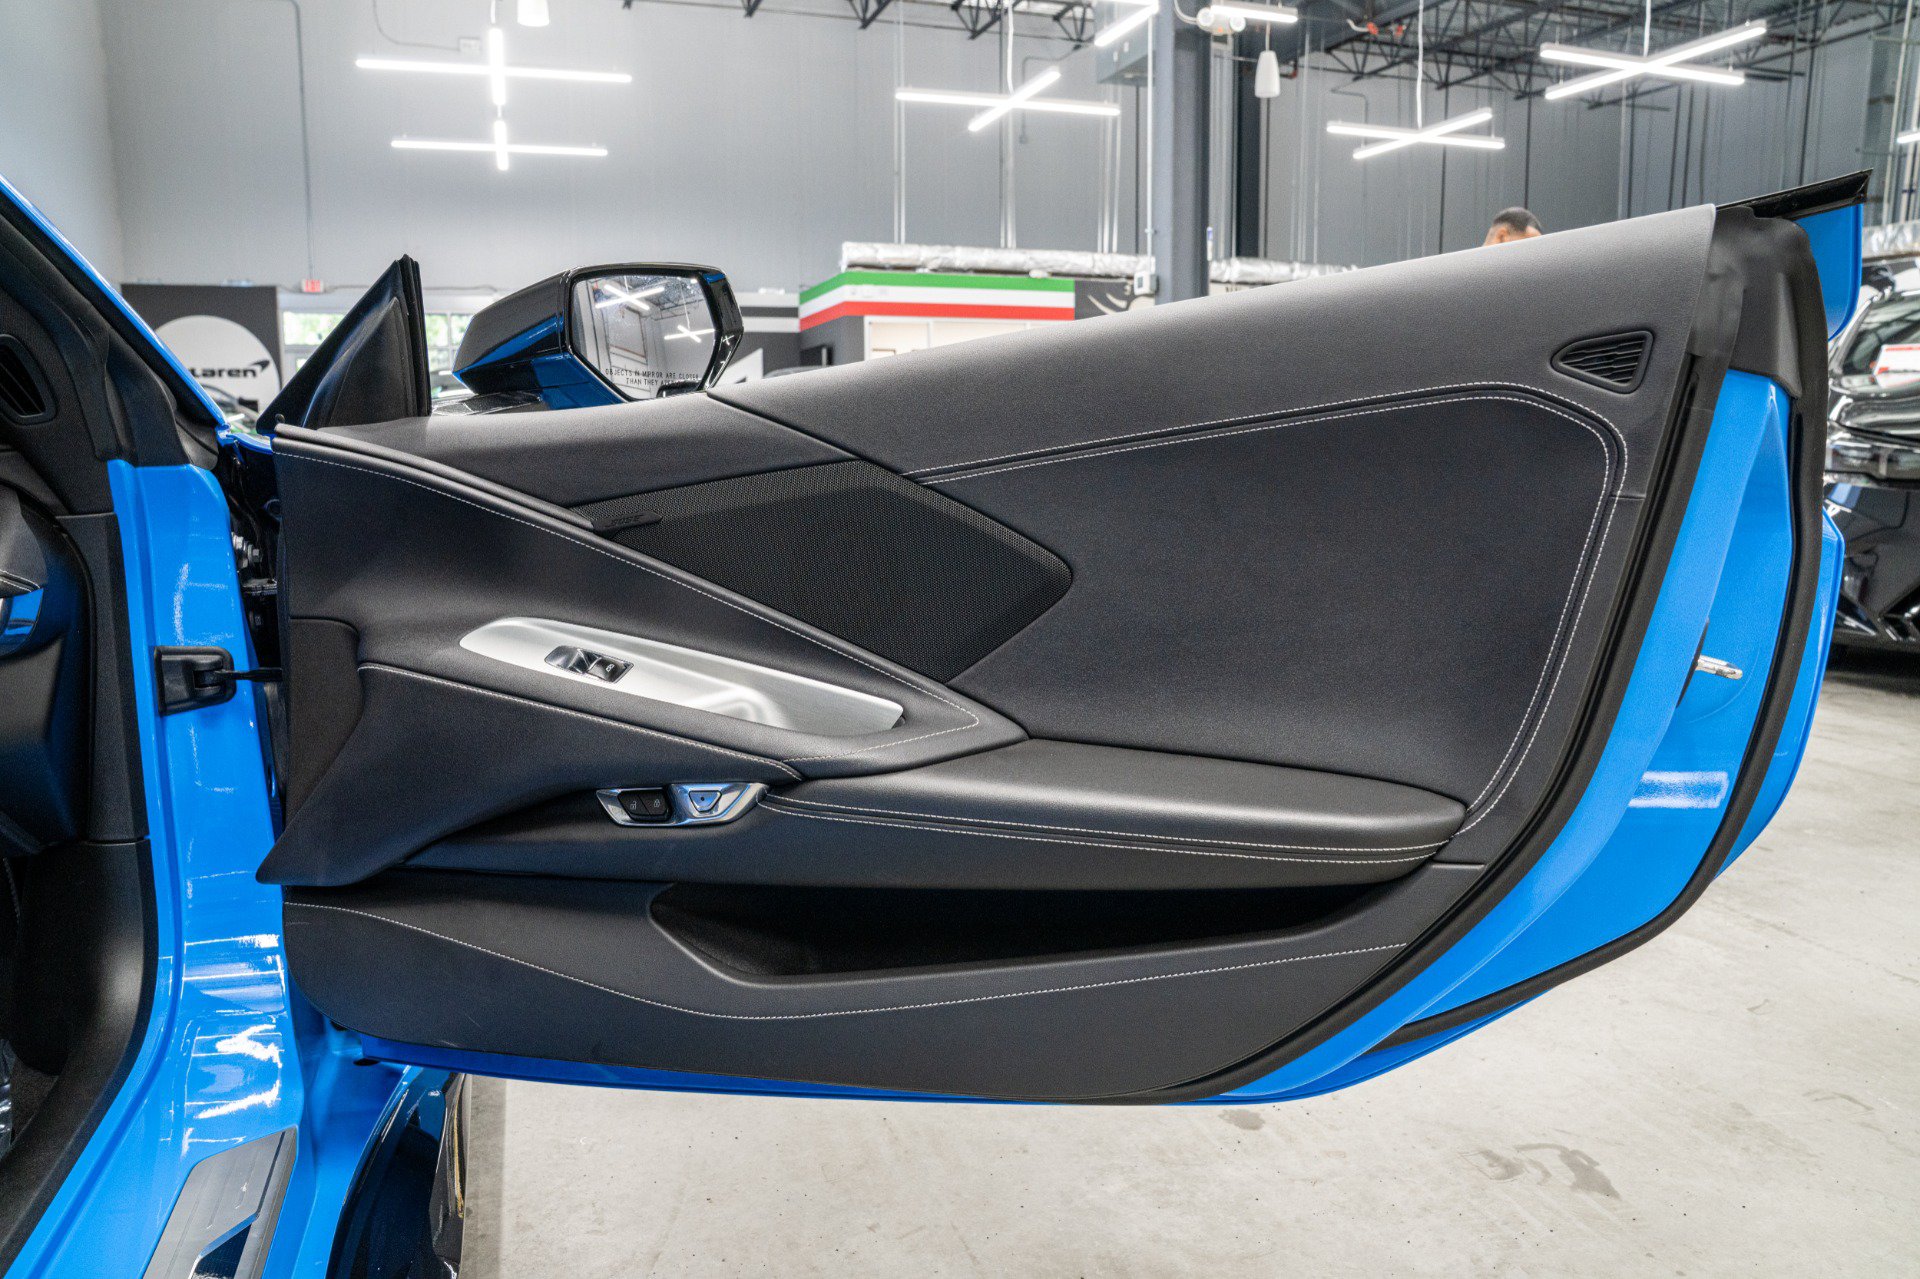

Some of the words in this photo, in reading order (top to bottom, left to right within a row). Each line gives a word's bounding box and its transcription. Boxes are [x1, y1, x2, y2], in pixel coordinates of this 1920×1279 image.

[605, 368, 632, 376] OBJECTS
[642, 371, 664, 379] MIRROR
[626, 377, 642, 385] THAN
[644, 378, 659, 386] THEY
